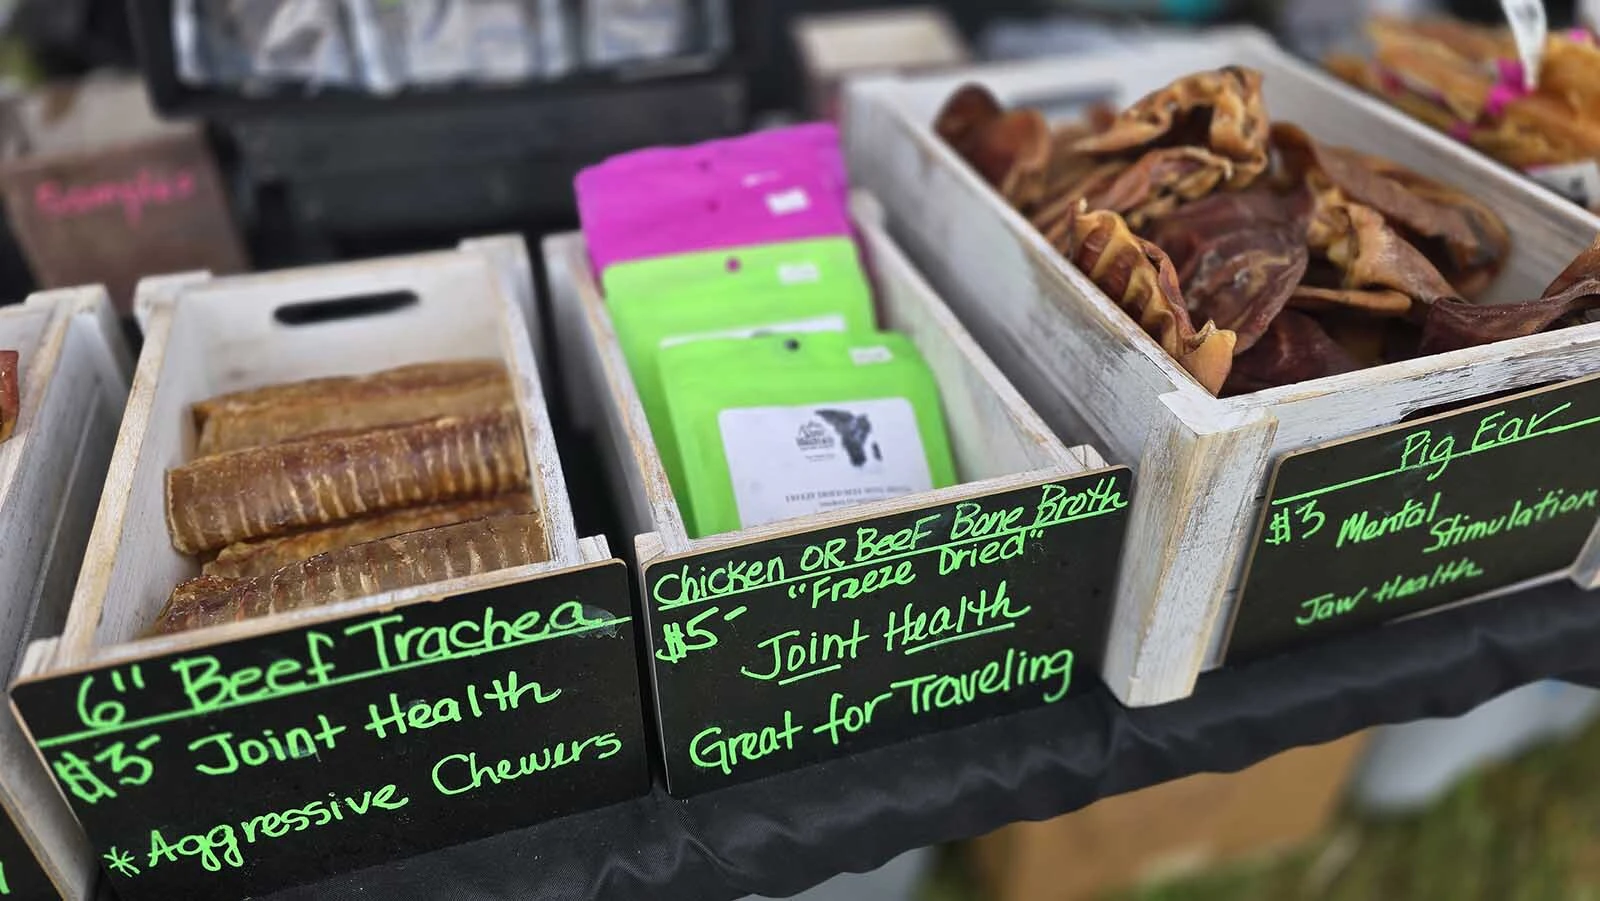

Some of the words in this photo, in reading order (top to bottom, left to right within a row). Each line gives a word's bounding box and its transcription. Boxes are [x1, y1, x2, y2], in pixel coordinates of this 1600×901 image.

[1399, 430, 1456, 481] Pig
[1472, 402, 1572, 451] Ear
[653, 556, 787, 604] Chicken
[799, 540, 847, 572] OR
[949, 502, 1026, 541] Bone
[1036, 477, 1129, 522] Broth
[1264, 499, 1326, 546] $3
[1336, 491, 1442, 548] Mental
[1422, 489, 1598, 554] Stimulation
[740, 620, 868, 681] Joint
[885, 579, 1031, 652] Health
[1294, 587, 1368, 626] Jaw
[1371, 557, 1484, 602] Health
[171, 631, 336, 710] Beef
[343, 600, 605, 673] Trachea
[187, 714, 346, 776] Joint
[364, 670, 562, 739] Health
[689, 710, 803, 775] Great
[812, 692, 892, 745] for
[889, 649, 1074, 714] Traveling
[431, 733, 622, 796] Chewers
